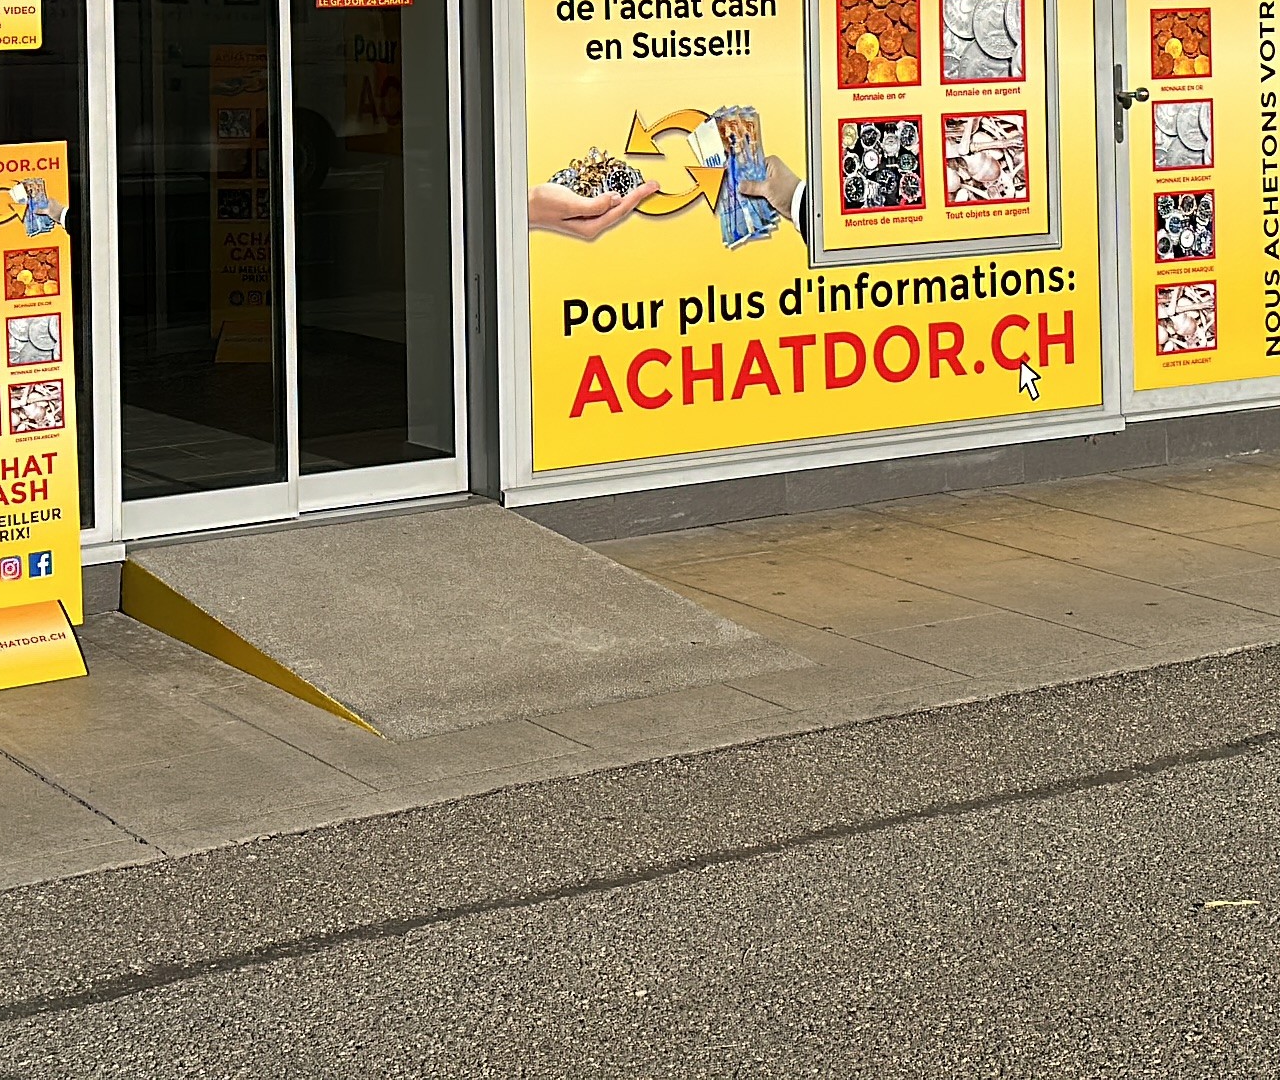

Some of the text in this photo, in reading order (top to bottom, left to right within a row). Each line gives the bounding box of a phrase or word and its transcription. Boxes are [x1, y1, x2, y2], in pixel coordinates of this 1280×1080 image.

[4, 6, 36, 14] VIDEO
[586, 30, 750, 60] en Suisse!!!
[946, 88, 979, 97] Monnaie
[995, 87, 1020, 96] argent
[1261, 91, 1280, 260] ACHETONS
[845, 218, 878, 227] Montres
[893, 215, 923, 224] marque
[563, 263, 1077, 338] Pour plus d'informations:
[1265, 269, 1280, 357] NOUS
[569, 309, 1076, 419] ACHATDOR.CH
